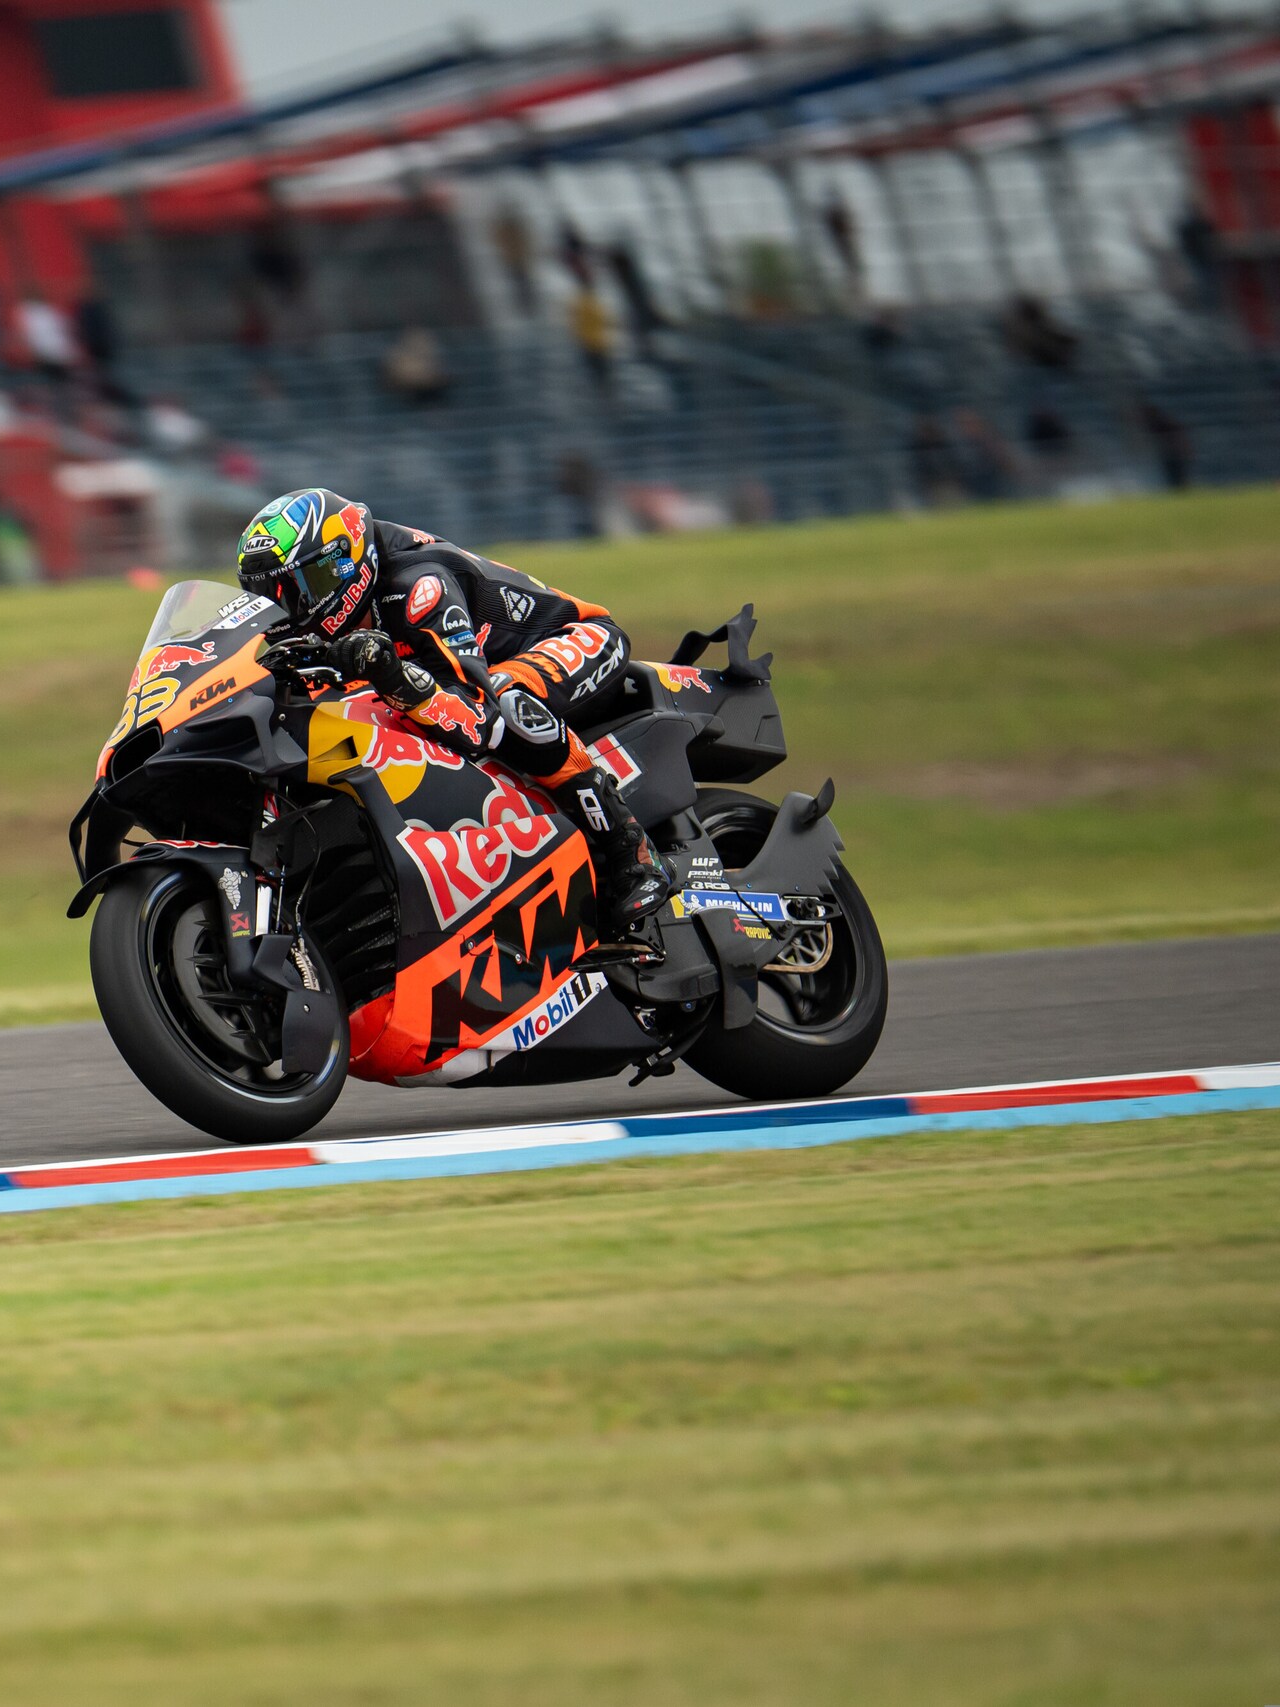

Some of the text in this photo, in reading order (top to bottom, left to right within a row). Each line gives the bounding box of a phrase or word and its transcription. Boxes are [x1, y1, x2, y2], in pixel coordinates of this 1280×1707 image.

[244, 538, 273, 551] HJC
[250, 574, 266, 582] YOU
[269, 560, 301, 577] WINGS
[217, 592, 251, 619] WRS
[320, 593, 357, 636] Red
[346, 562, 373, 605] Bull
[229, 607, 254, 625] Mobil
[189, 676, 237, 711] KTM
[396, 770, 559, 931] Red
[692, 857, 719, 867] WP
[687, 869, 724, 879] pankl
[705, 898, 773, 913] MICHELIN
[424, 859, 600, 1066] KTM
[512, 984, 577, 1051] Mobil
